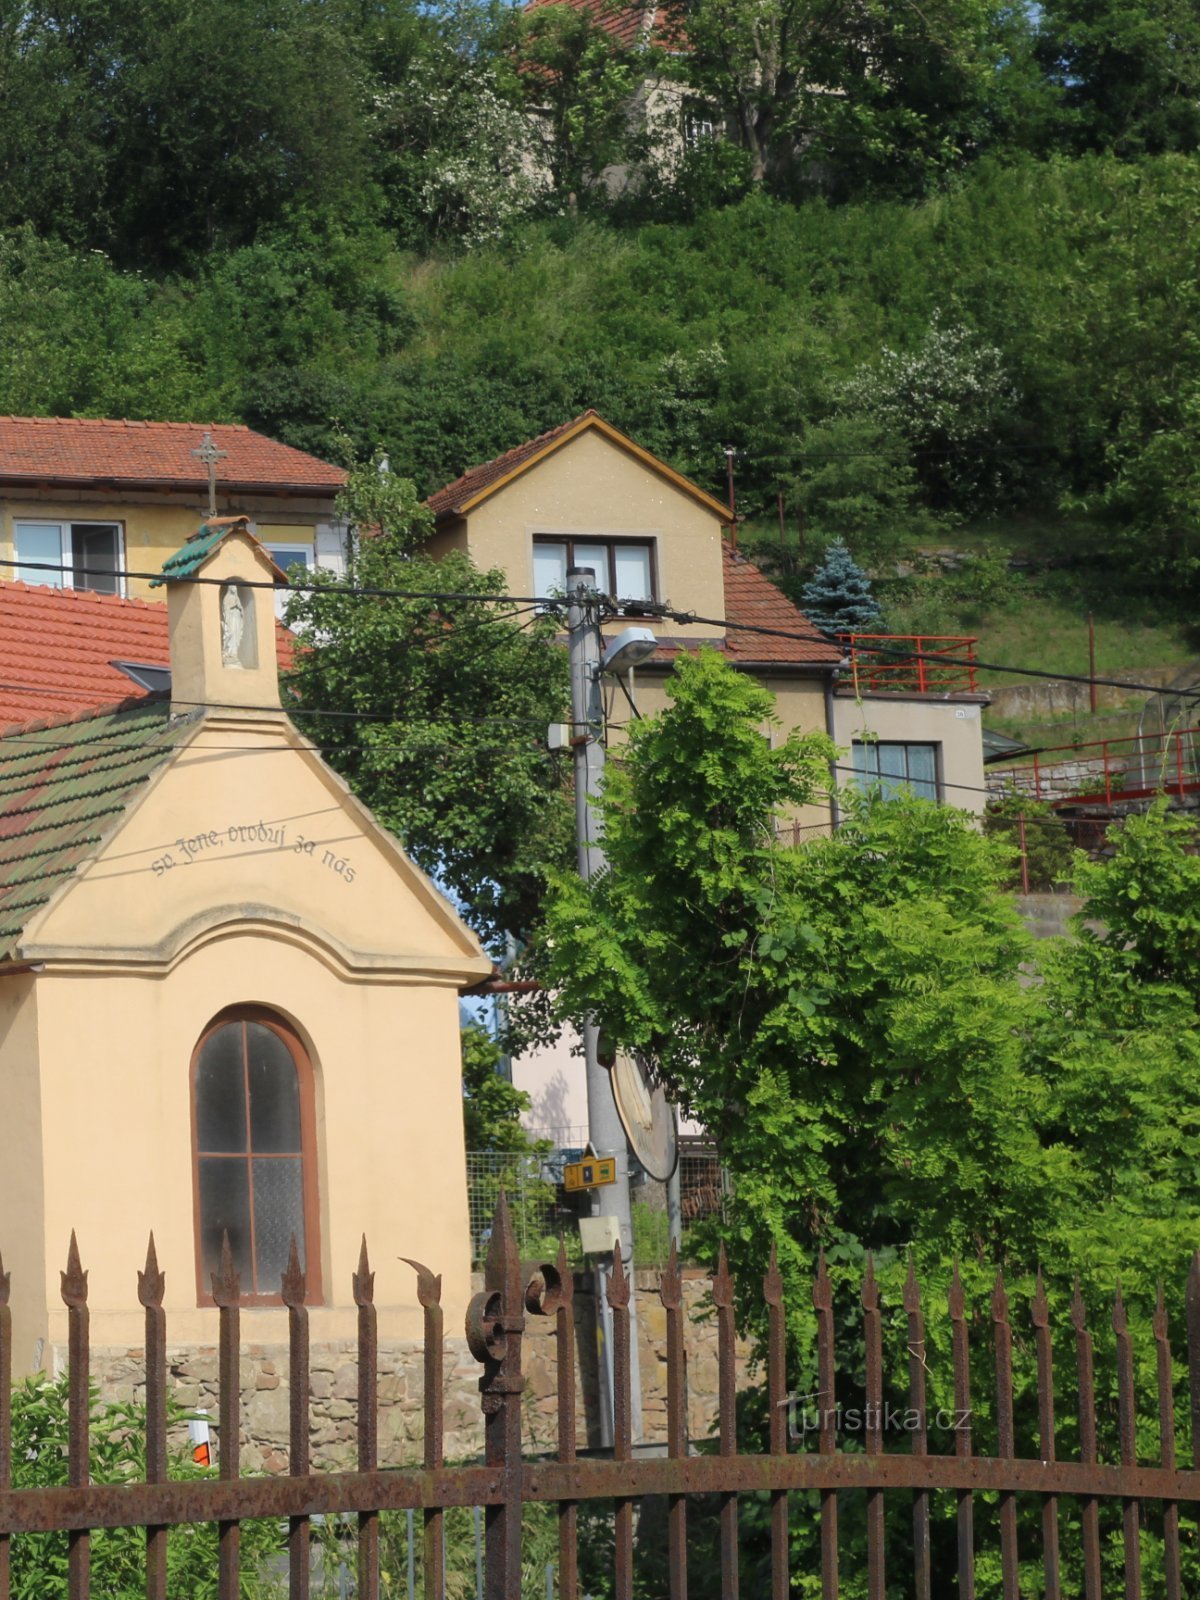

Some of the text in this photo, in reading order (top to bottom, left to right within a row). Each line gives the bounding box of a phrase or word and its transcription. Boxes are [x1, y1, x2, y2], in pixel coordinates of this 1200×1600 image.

[151, 853, 177, 877] sv.
[294, 834, 316, 856] za
[321, 850, 357, 883] nás
